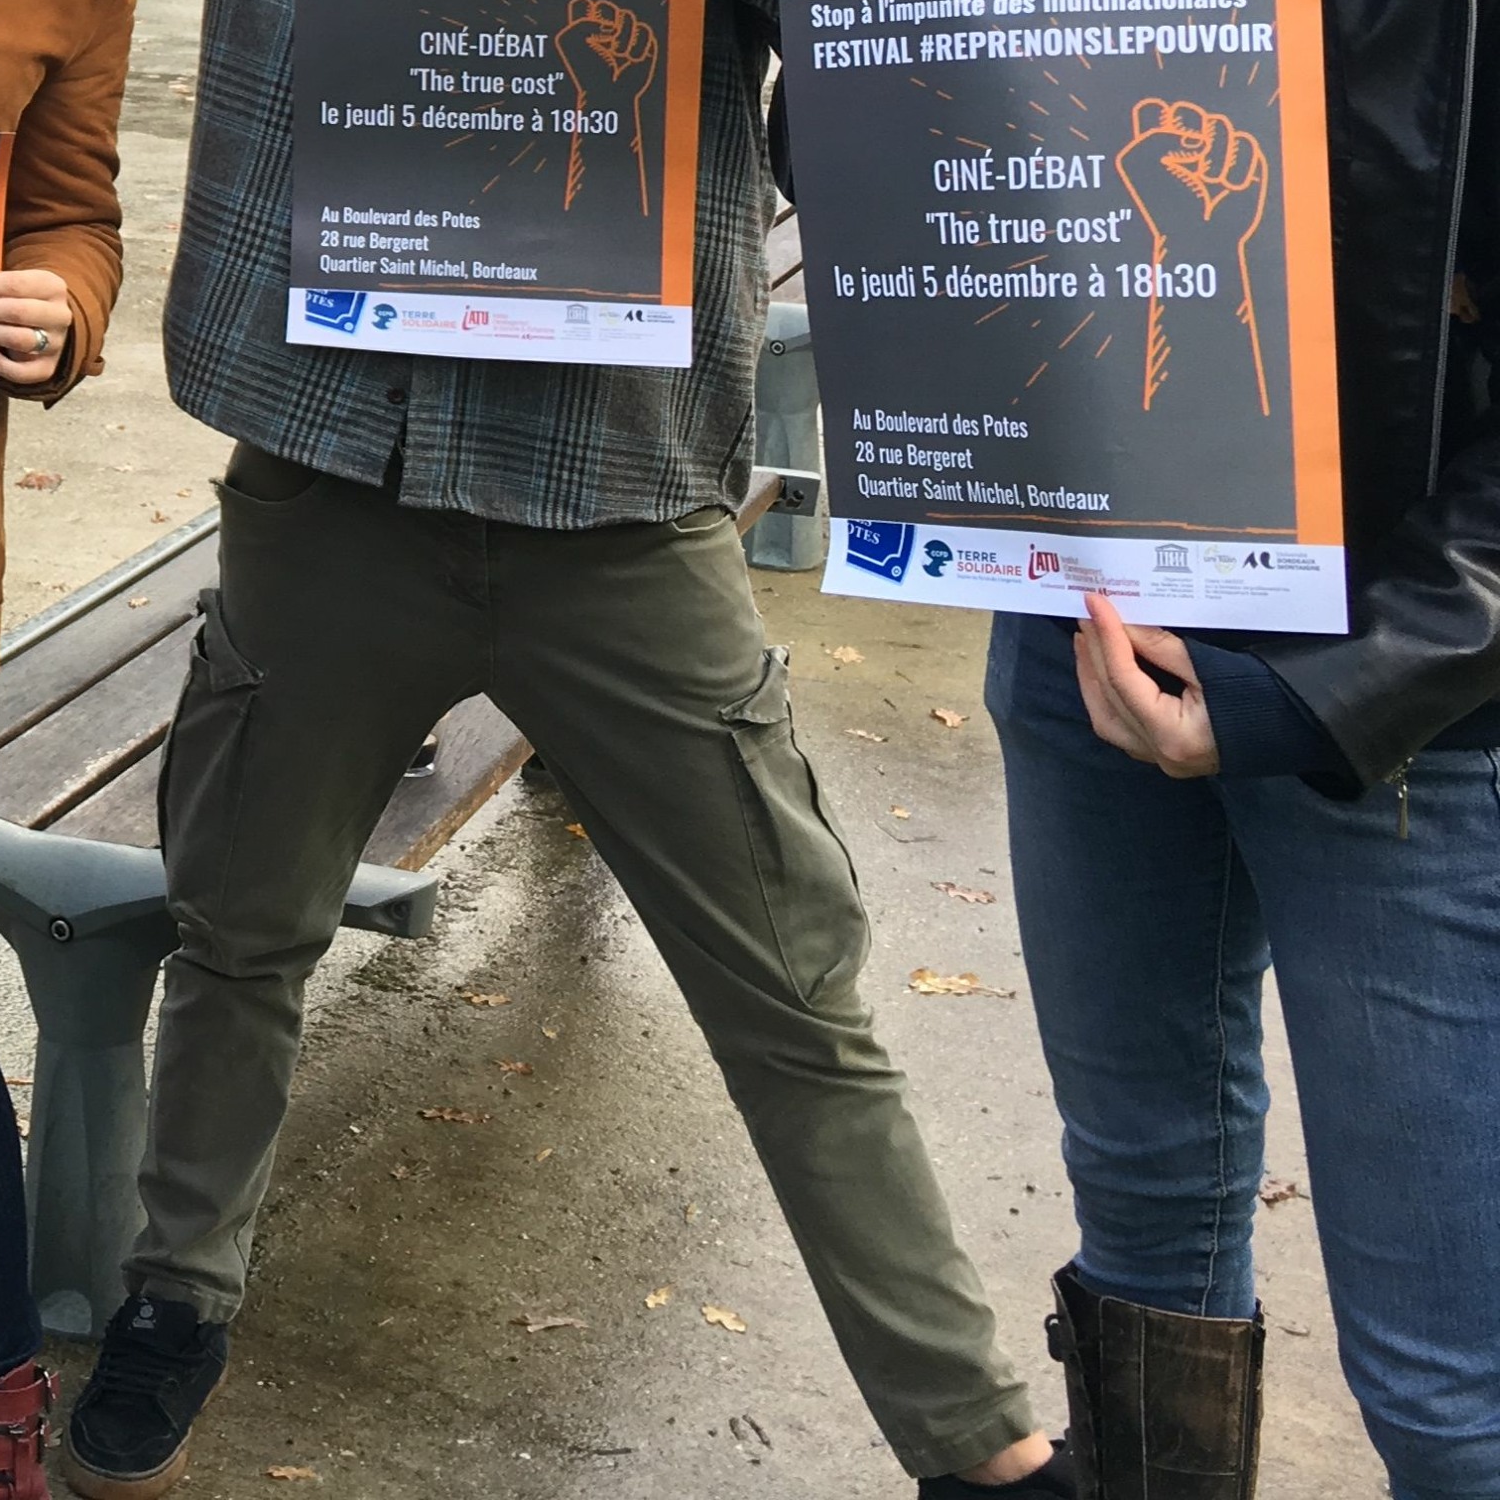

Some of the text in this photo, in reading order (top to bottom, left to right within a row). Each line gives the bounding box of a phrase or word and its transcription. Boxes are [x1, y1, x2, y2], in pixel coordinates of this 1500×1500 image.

[810, 4, 856, 31] Stop
[861, 0, 873, 24] à
[420, 26, 549, 58] CINÉ-DÉBAT
[813, 23, 1273, 70] FESTIVAL #REPRENONSLEPOUVOIR
[410, 68, 564, 96] "The true cost"
[321, 101, 618, 134] le jeudi 5 décembre à 18h30
[934, 146, 1106, 192] CINÉ-DÉBAT
[320, 206, 481, 229] Au Boulevard des Potes
[925, 208, 1132, 245] "The true cost"
[320, 230, 430, 254] 28 rue Bergeret
[320, 254, 538, 281] Quartier Saint Michel, Bordeaux
[834, 263, 1217, 302] le jeudi 5 décembre à 18h30
[853, 408, 1029, 439] Au Boulevard des Potes
[855, 440, 974, 472] 28 rue Bergeret
[858, 473, 1110, 511] Quartier Saint Michel, Bordeaux
[957, 550, 997, 563] TERRE
[957, 562, 1022, 576] SOLIDAIRE
